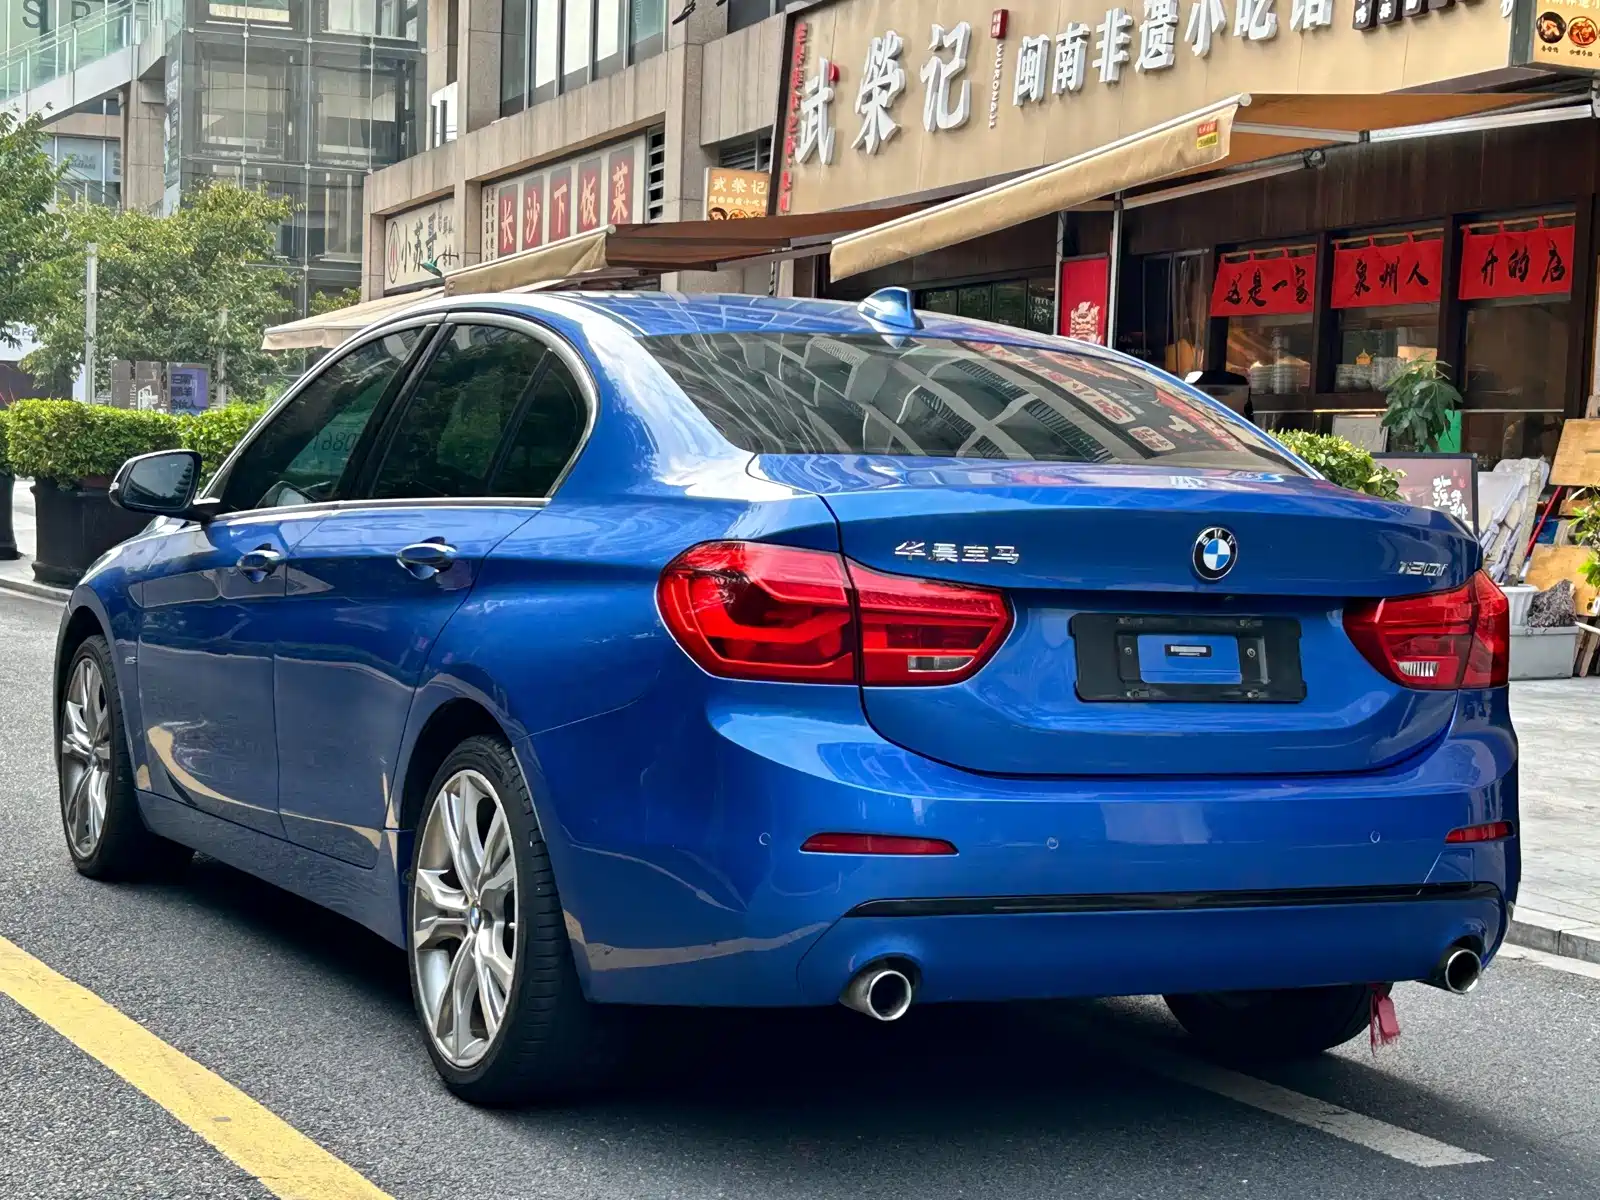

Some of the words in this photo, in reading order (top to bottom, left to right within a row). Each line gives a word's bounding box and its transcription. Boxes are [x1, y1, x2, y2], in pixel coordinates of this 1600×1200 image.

[501, 161, 629, 250] 长沙下饭菜
[1481, 239, 1566, 288] 开的店
[894, 541, 1020, 565] 华晨宝马
